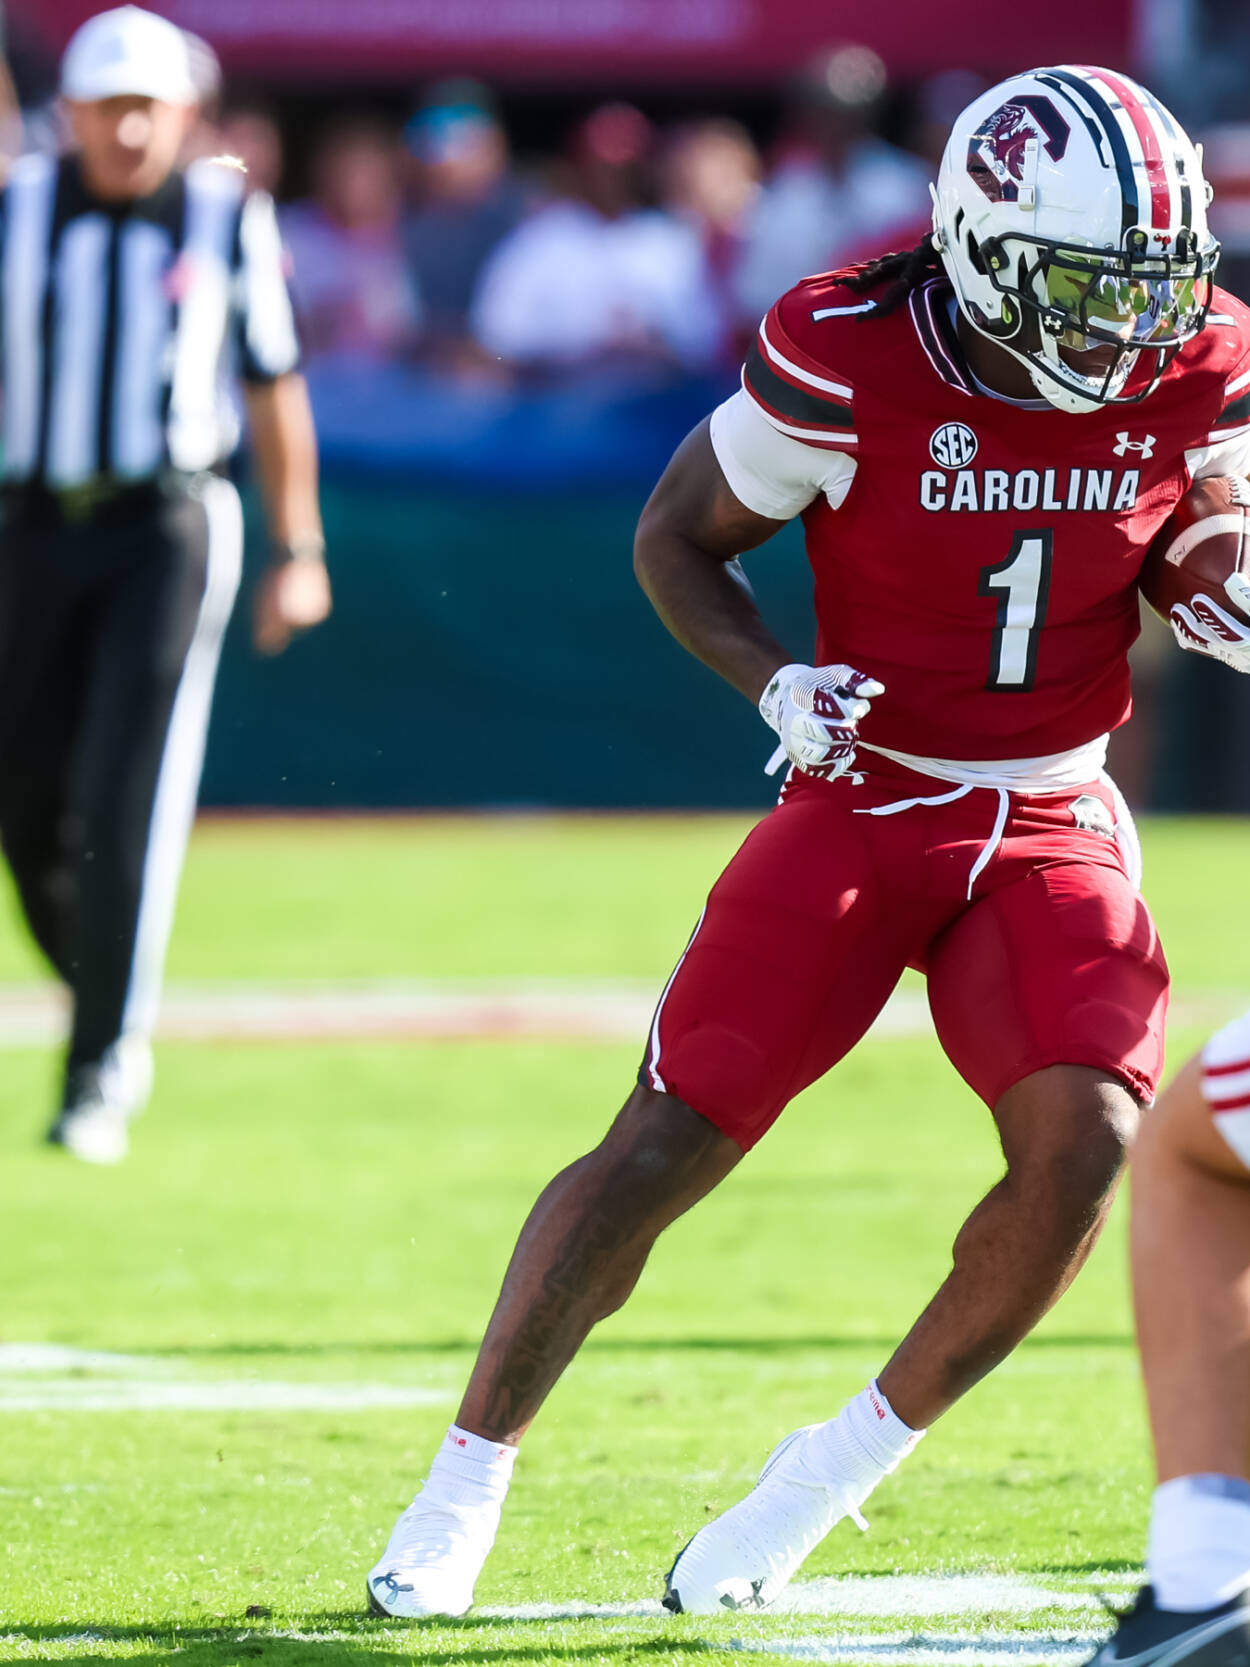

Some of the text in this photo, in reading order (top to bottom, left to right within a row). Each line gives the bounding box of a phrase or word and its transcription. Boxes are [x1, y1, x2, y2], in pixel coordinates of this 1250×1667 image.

[932, 425, 977, 467] SEC
[919, 468, 1141, 513] CAROLINA
[976, 528, 1054, 693] 1
